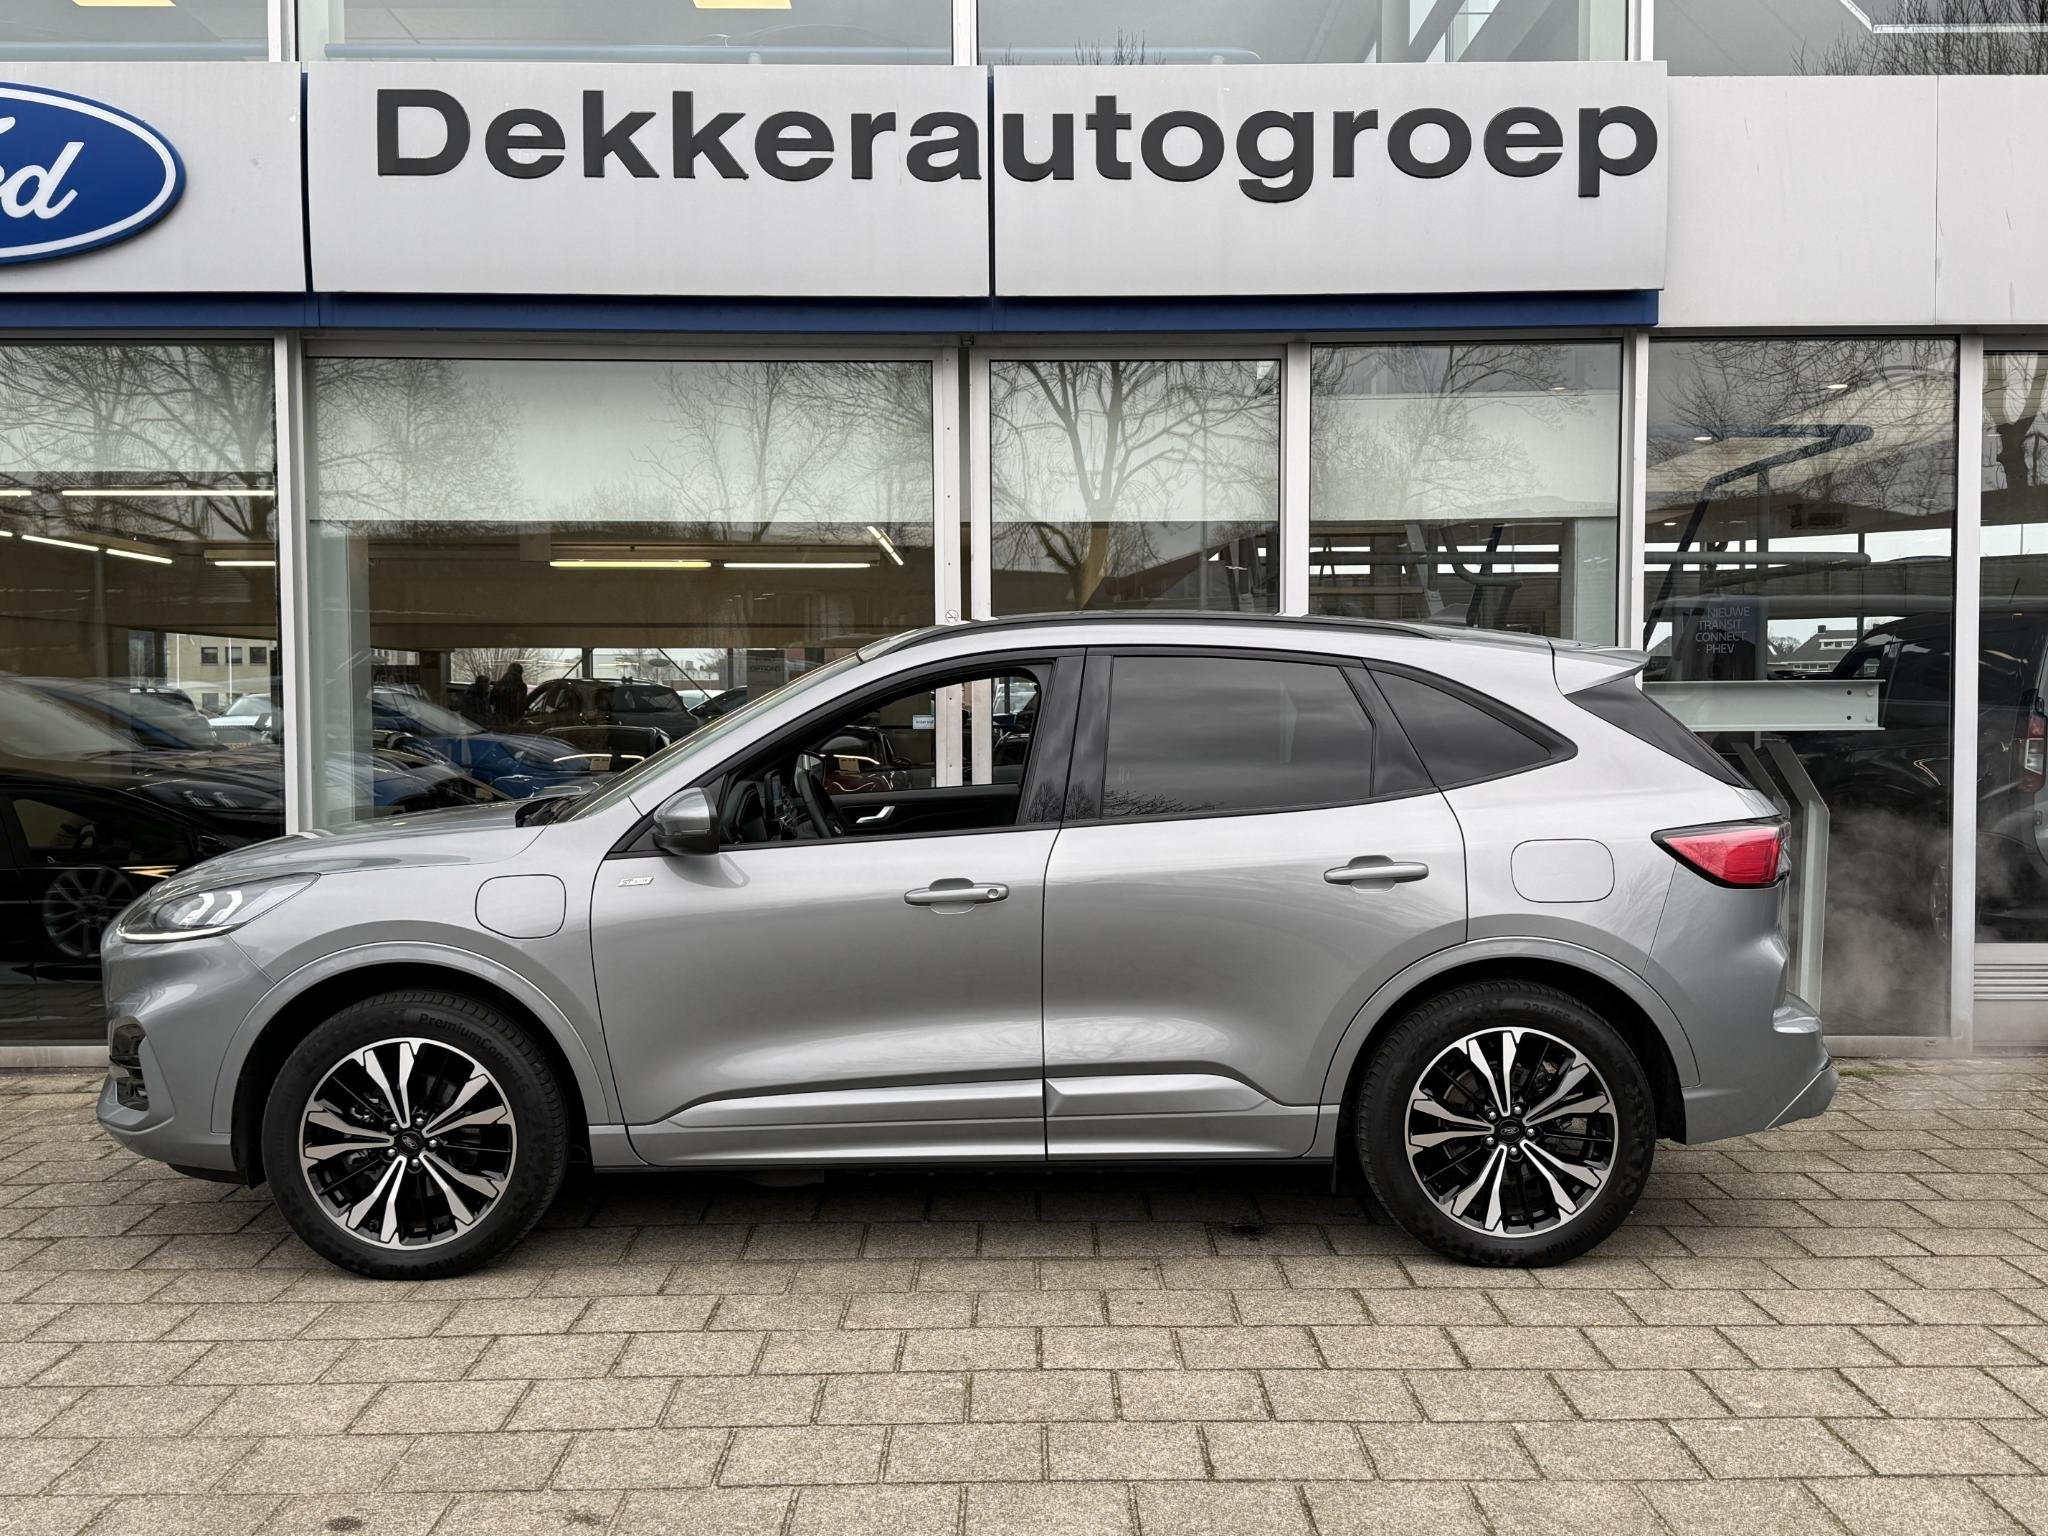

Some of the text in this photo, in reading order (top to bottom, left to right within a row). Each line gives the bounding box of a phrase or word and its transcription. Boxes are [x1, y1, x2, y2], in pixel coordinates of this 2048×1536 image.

[377, 88, 1658, 203] Dekkerautogroep
[1707, 606, 1751, 618] NIEUWE
[1697, 619, 1743, 631] TRANSIT
[1695, 631, 1746, 642] CONNECT
[1706, 643, 1735, 654] PHEV
